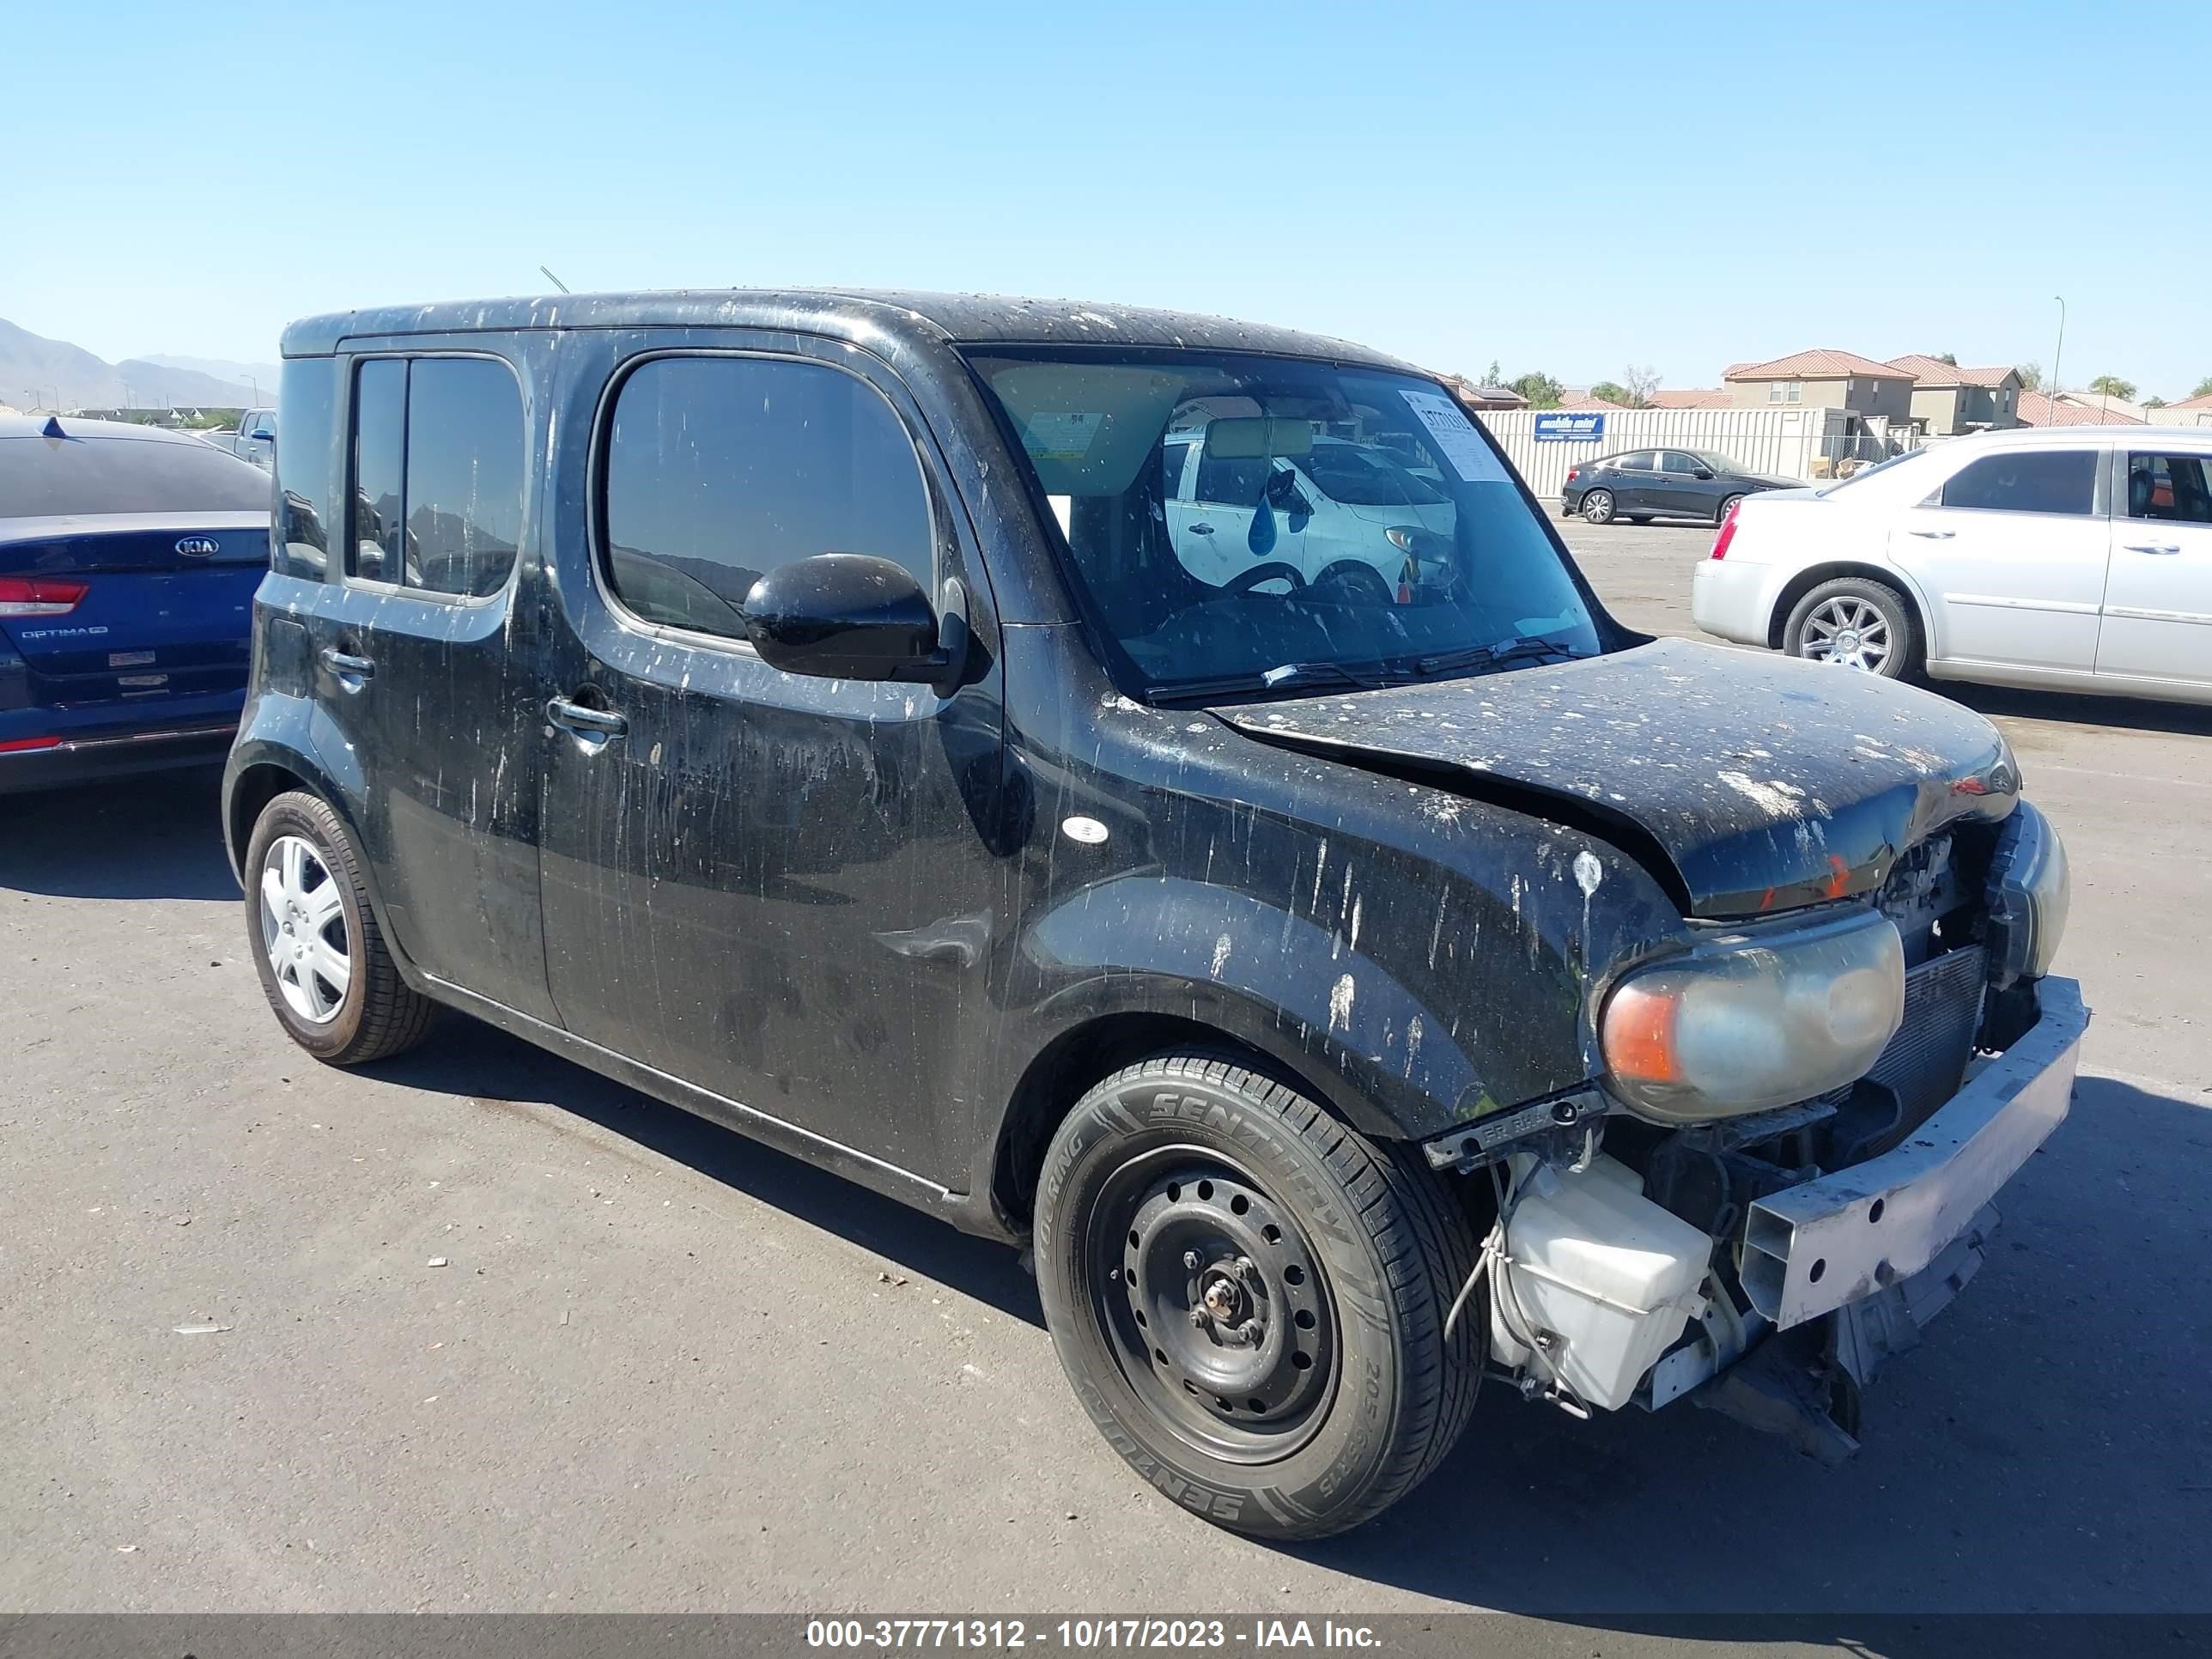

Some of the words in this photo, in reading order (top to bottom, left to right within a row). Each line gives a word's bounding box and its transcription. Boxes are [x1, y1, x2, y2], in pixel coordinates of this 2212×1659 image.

[1540, 416, 1573, 428] mobile
[1572, 417, 1598, 428] mini
[183, 540, 213, 553] KIA
[21, 628, 87, 639] OPTIMA
[1039, 1130, 1084, 1261] TOURING
